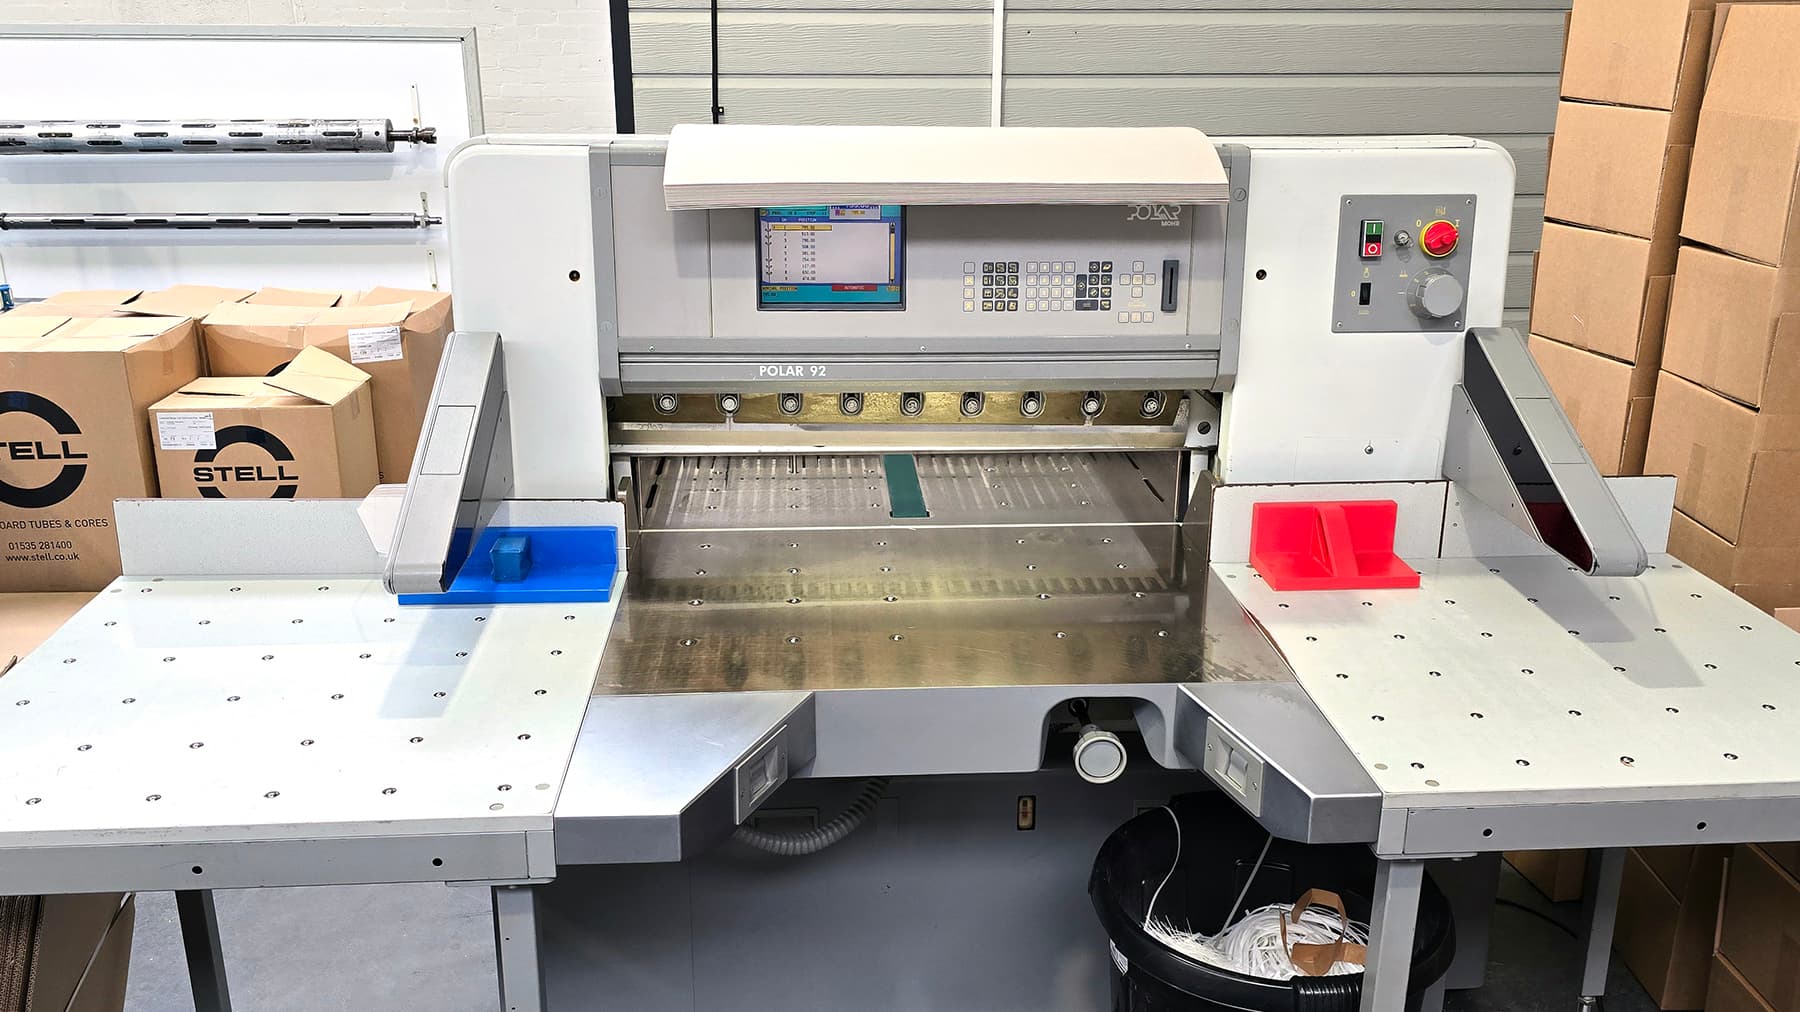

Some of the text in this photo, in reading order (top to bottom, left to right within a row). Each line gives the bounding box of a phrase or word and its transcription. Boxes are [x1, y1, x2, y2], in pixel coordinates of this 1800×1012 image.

[760, 365, 826, 377] POLAR 92
[0, 441, 88, 460] ELL
[193, 465, 299, 482] STELL
[28, 520, 61, 529] TUBES
[64, 519, 72, 528] &
[75, 518, 109, 528] CORES
[8, 541, 73, 550] 01535 281400
[5, 552, 80, 562] www.stell.co.uk
